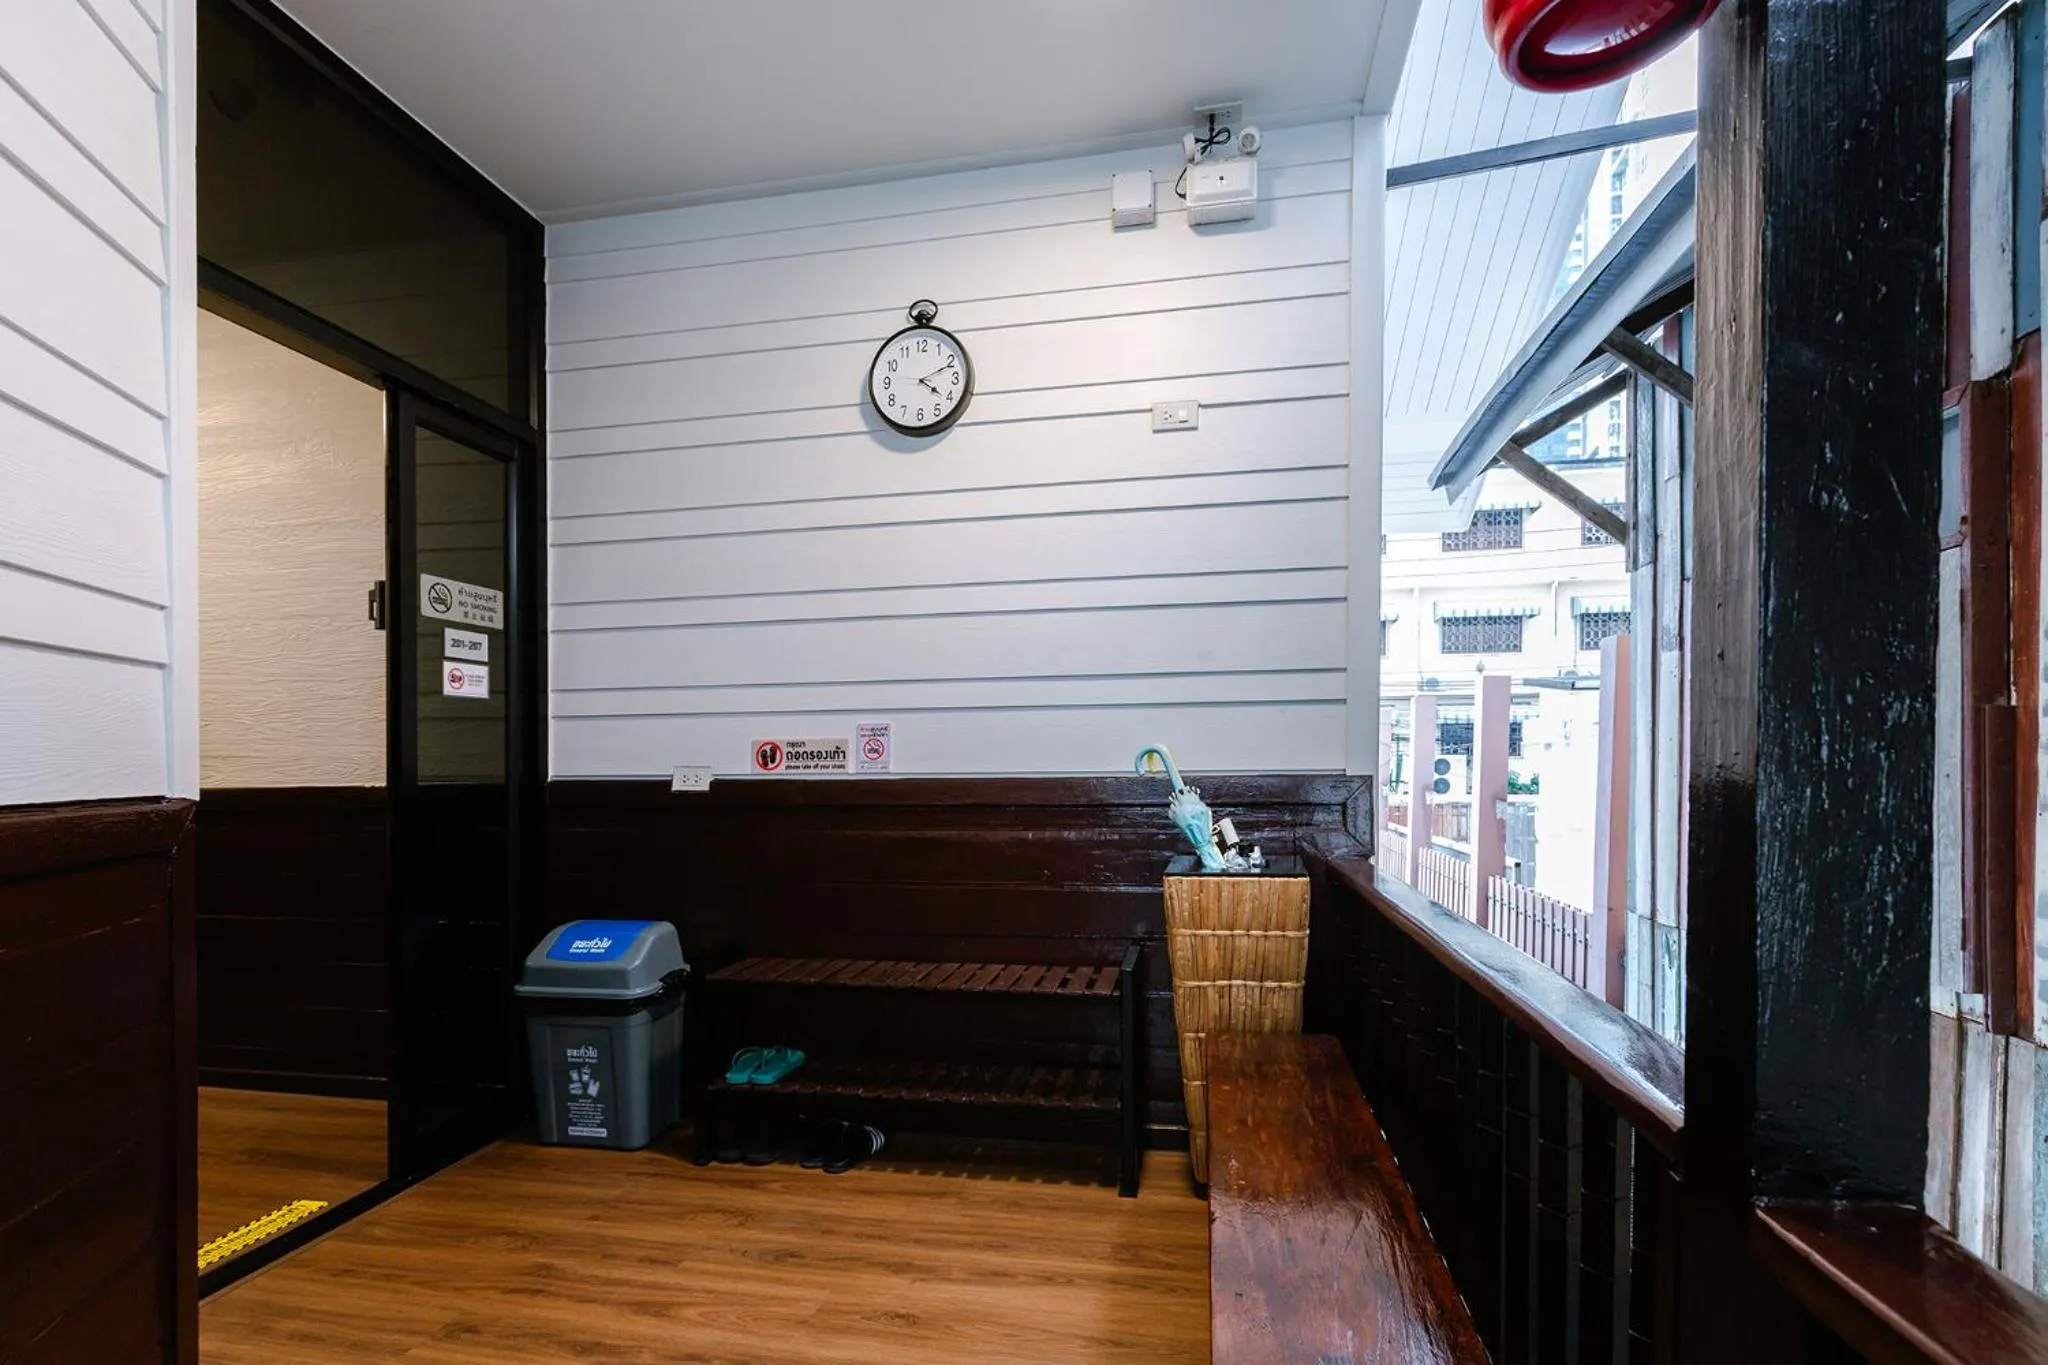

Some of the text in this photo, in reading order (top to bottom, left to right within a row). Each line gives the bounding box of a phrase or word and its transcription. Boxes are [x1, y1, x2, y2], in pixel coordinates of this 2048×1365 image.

[900, 345, 910, 358] 11
[916, 340, 928, 353] 12
[937, 343, 941, 356] 1
[887, 359, 898, 372] 10
[947, 354, 955, 368] 2
[883, 376, 891, 390] 9
[951, 371, 960, 386] 3
[888, 393, 896, 407] 8
[946, 390, 953, 403] 4
[900, 405, 908, 418] 7
[916, 408, 924, 422] 6
[933, 403, 941, 417] 5
[786, 745, 847, 761] ถอดรองเท้า
